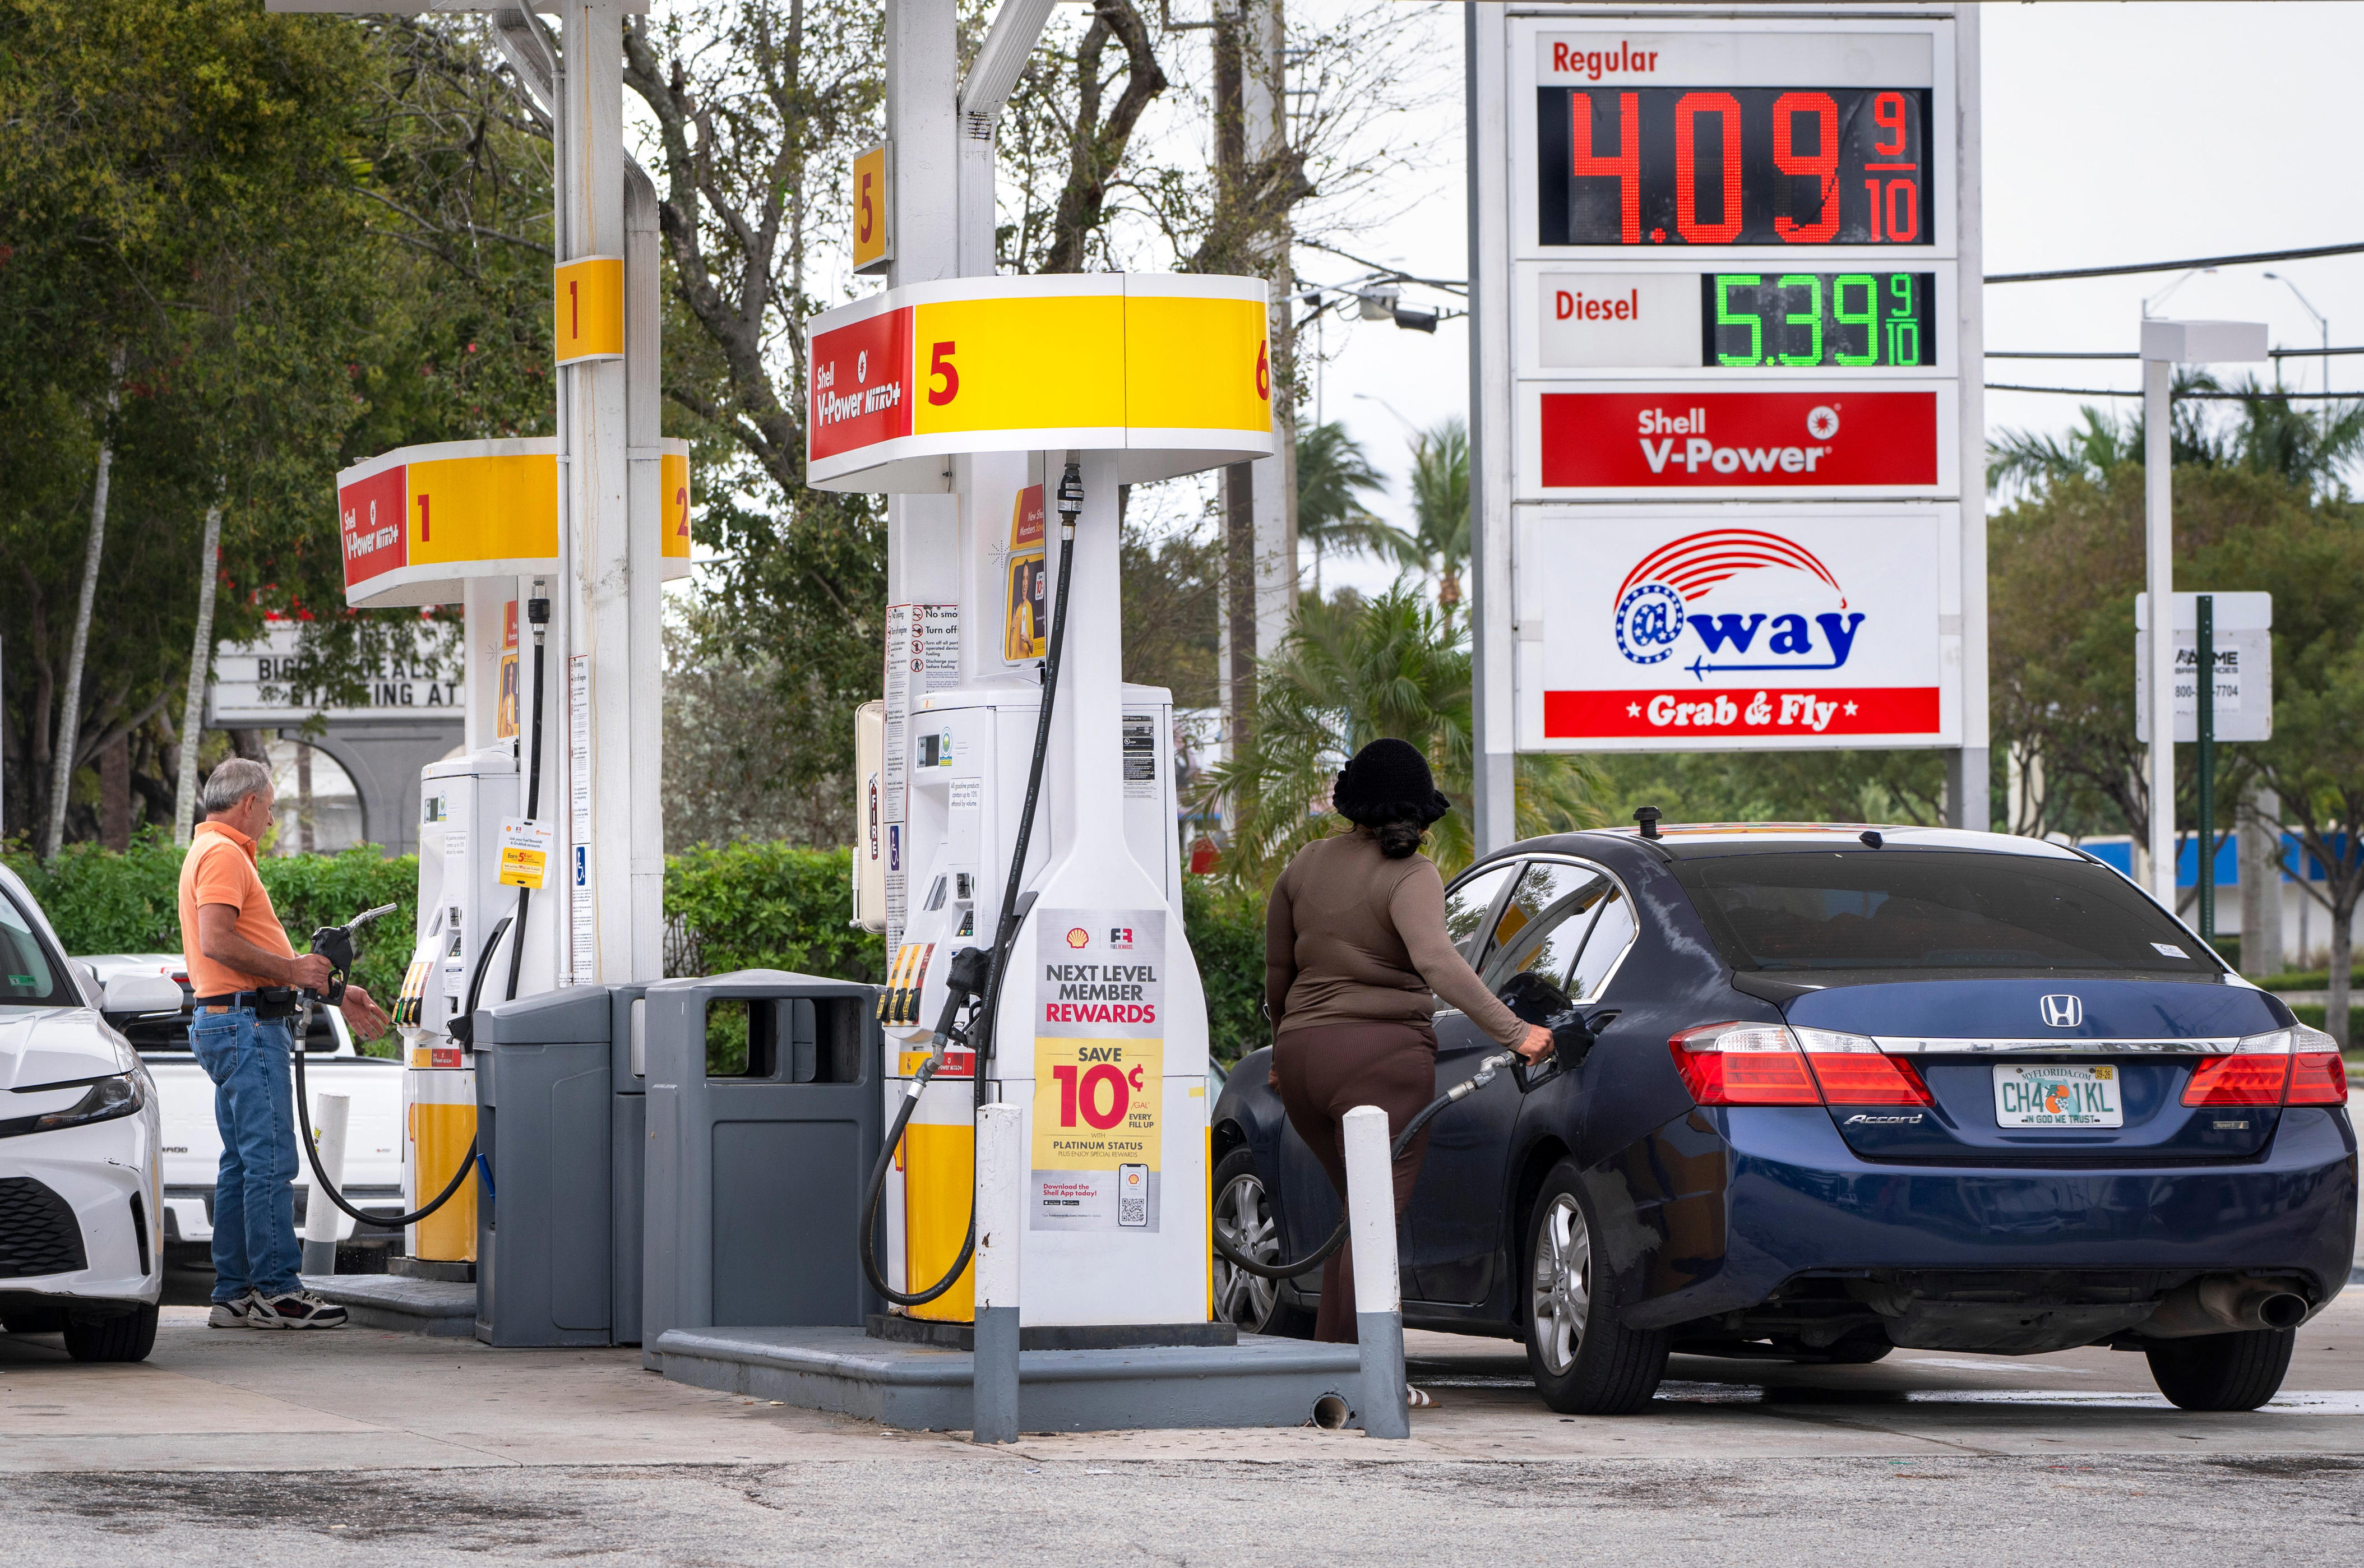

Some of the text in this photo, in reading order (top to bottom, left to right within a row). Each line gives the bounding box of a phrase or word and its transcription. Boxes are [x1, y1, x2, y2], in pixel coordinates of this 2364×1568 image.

[1553, 41, 1658, 80] Regular
[1874, 92, 1905, 155] 9
[1573, 92, 1839, 243] 4.09
[861, 172, 872, 244] 5
[1865, 179, 1917, 242] 10
[570, 281, 577, 339] 1
[1557, 289, 1638, 320] Diesel
[1891, 274, 1912, 317] 9
[1717, 275, 1878, 367] 5.39
[1886, 322, 1918, 366] 10
[817, 361, 835, 390] Shell
[928, 341, 959, 406] 5
[1256, 340, 1269, 401] 6
[817, 390, 862, 428] V-Power
[1639, 408, 1705, 434] Shell
[1639, 438, 1824, 474] V-Power
[344, 508, 356, 531] Shell
[418, 494, 429, 542] 1
[676, 487, 689, 536] 2
[1028, 511, 1036, 522] New
[1019, 524, 1035, 536] Members
[346, 531, 375, 561] V-Power
[946, 625, 957, 633] off
[1615, 584, 1866, 670] @way
[428, 683, 457, 705] AT
[2175, 685, 2238, 697] 800--7704
[1647, 691, 1838, 732] Grab & Fly
[955, 782, 966, 790] gasoline
[967, 781, 980, 790] products
[962, 799, 966, 808] by
[1047, 965, 1157, 982] NEXT LEVEL
[1059, 984, 1144, 1001] MEMBER
[1046, 1003, 1156, 1024] REWARDS
[1078, 1047, 1122, 1062] SAVE
[2097, 1069, 2111, 1080] 09-26
[1843, 1113, 1923, 1125] Accord
[2026, 1114, 2095, 1124] IN GOD WE TRUST
